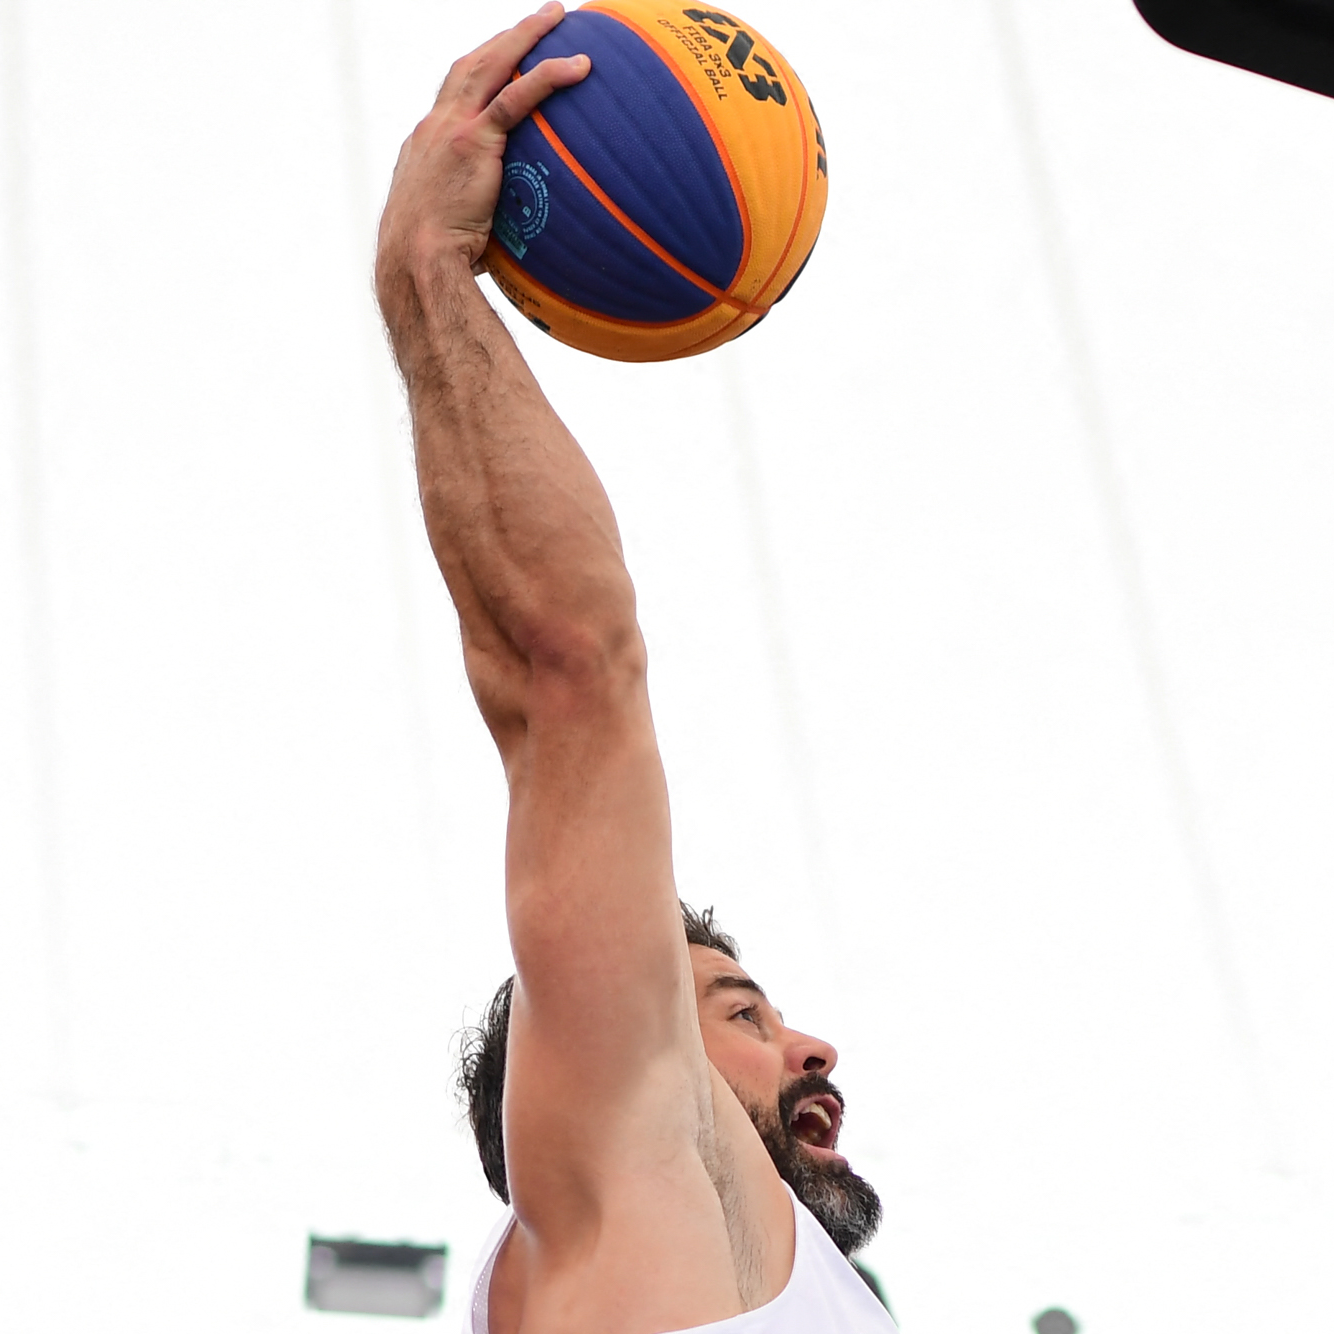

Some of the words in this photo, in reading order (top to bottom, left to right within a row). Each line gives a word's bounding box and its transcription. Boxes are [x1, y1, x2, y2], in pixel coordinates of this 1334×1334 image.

[657, 19, 708, 66] OFFICIAL
[704, 68, 728, 101] BALL
[682, 25, 713, 52] FIBA
